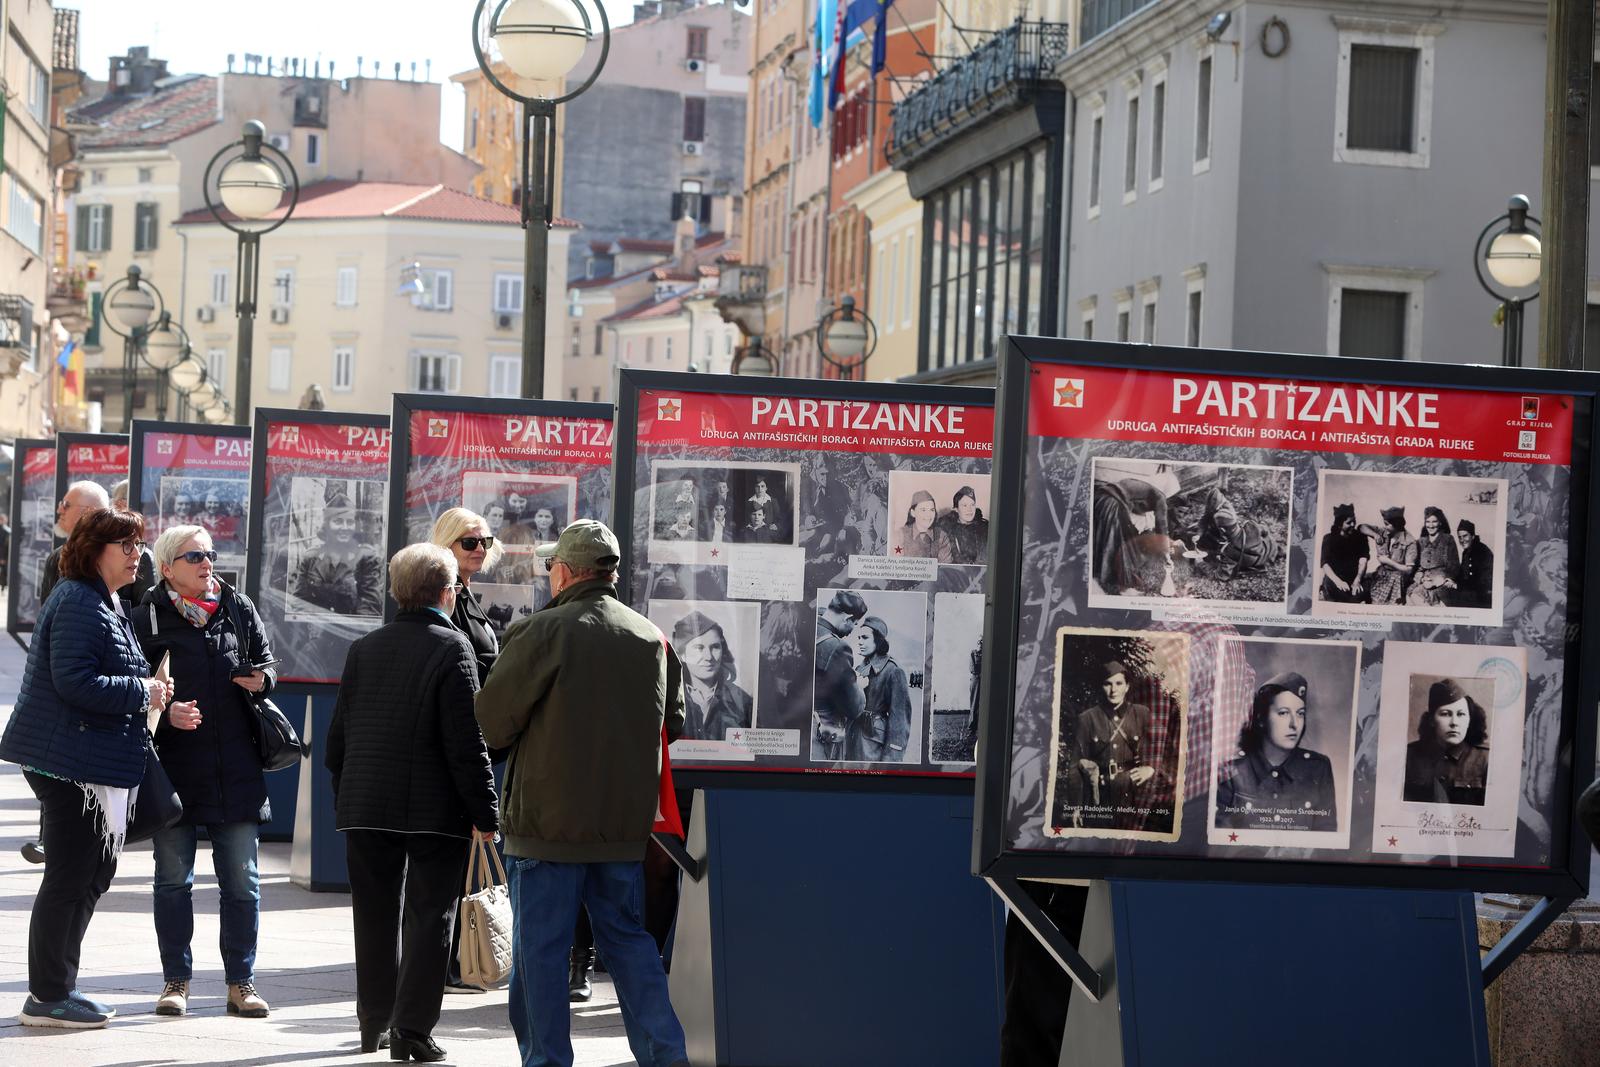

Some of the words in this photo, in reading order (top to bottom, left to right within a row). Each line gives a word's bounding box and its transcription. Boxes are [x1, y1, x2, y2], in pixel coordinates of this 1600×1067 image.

[700, 430, 739, 440] UDRUGA
[743, 431, 818, 443] ANTIFAŠISTIČKIH
[822, 435, 859, 445] BORACA
[870, 435, 926, 447] ANTIFAŠISTA
[929, 440, 960, 450] GRADA
[964, 441, 992, 451] RIJEKE
[1108, 420, 1156, 432] UDRUGA
[1162, 422, 1254, 438] ANTIFAŠISTIČKIH
[1260, 428, 1306, 440] BORACA
[1312, 432, 1315, 440] I
[1320, 431, 1390, 445] ANTIFAŠISTA
[1395, 436, 1434, 448] GRADA
[1439, 439, 1474, 450] RIJEKE
[463, 444, 495, 453] UDRUGA
[499, 445, 561, 456] ANTIFAŠISTIČKIH
[564, 450, 595, 458] BORACA
[1085, 805, 1112, 813] Radojević
